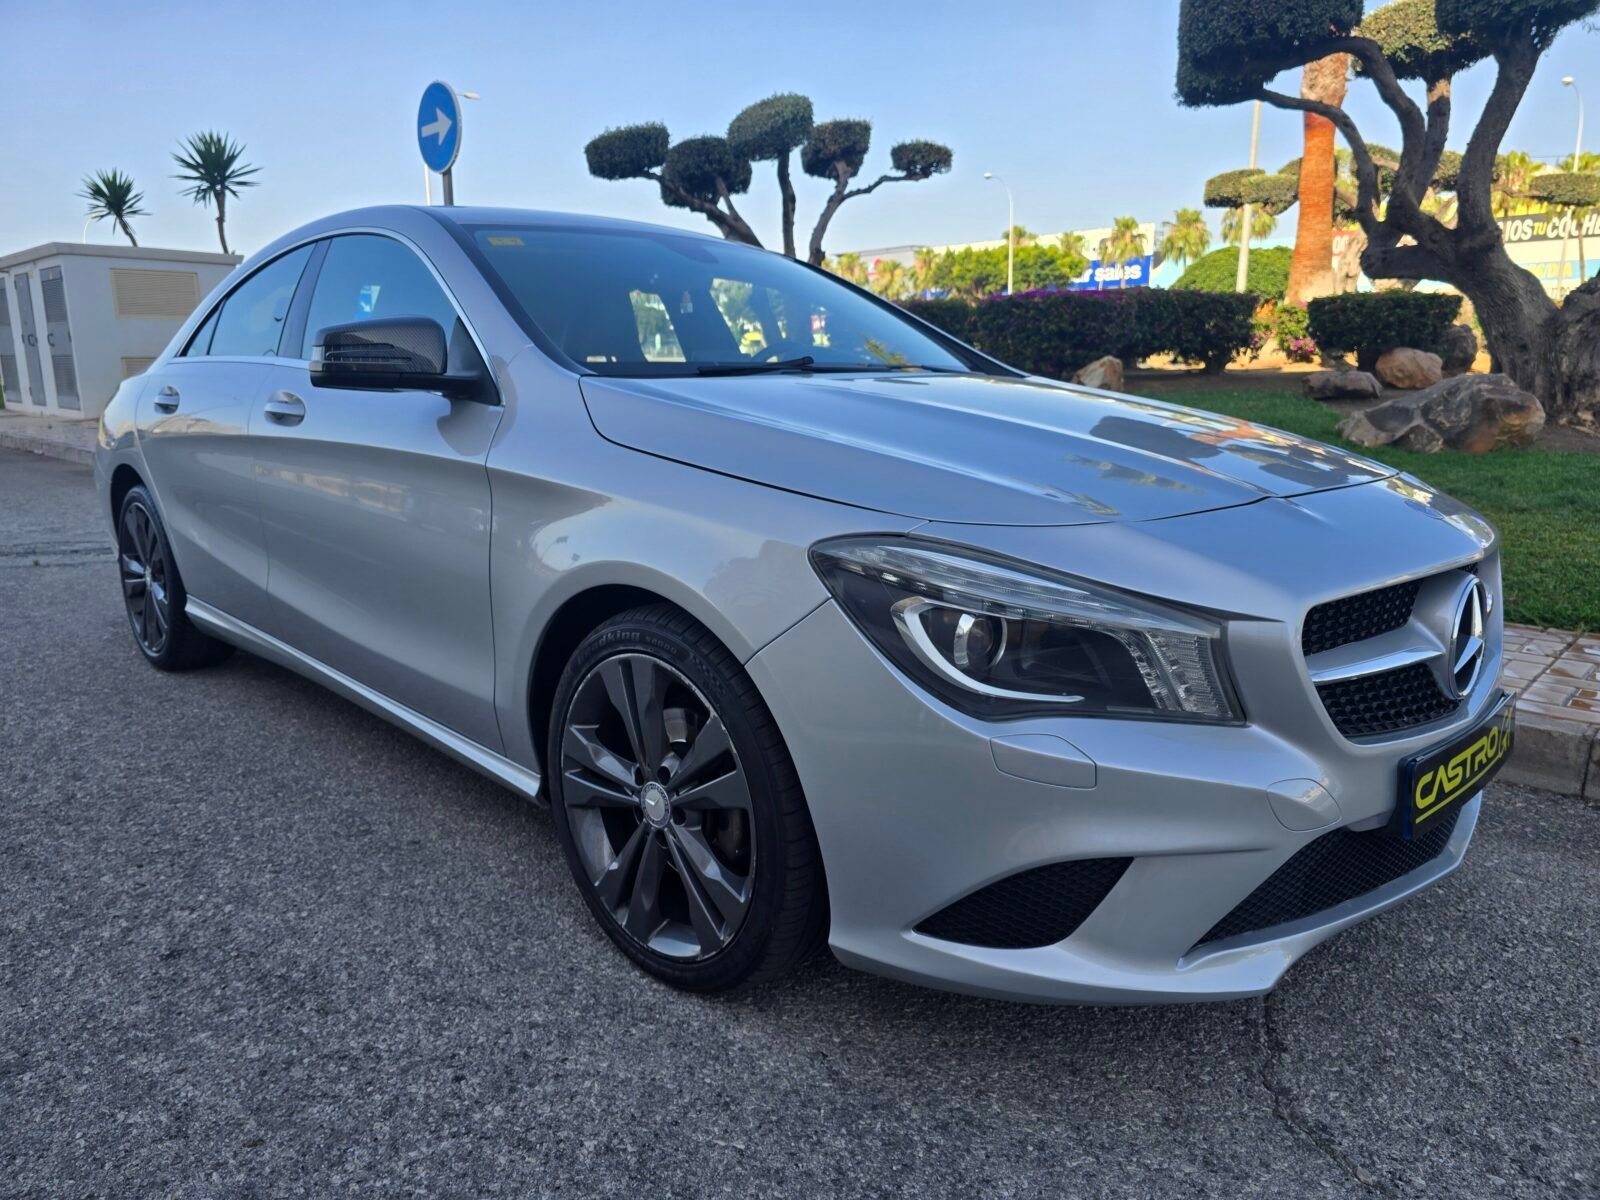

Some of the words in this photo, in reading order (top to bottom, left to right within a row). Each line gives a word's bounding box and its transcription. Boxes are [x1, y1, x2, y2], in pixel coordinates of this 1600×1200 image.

[1533, 222, 1547, 236] TU
[1094, 263, 1142, 281] sales
[1416, 727, 1498, 809] CASTRO
